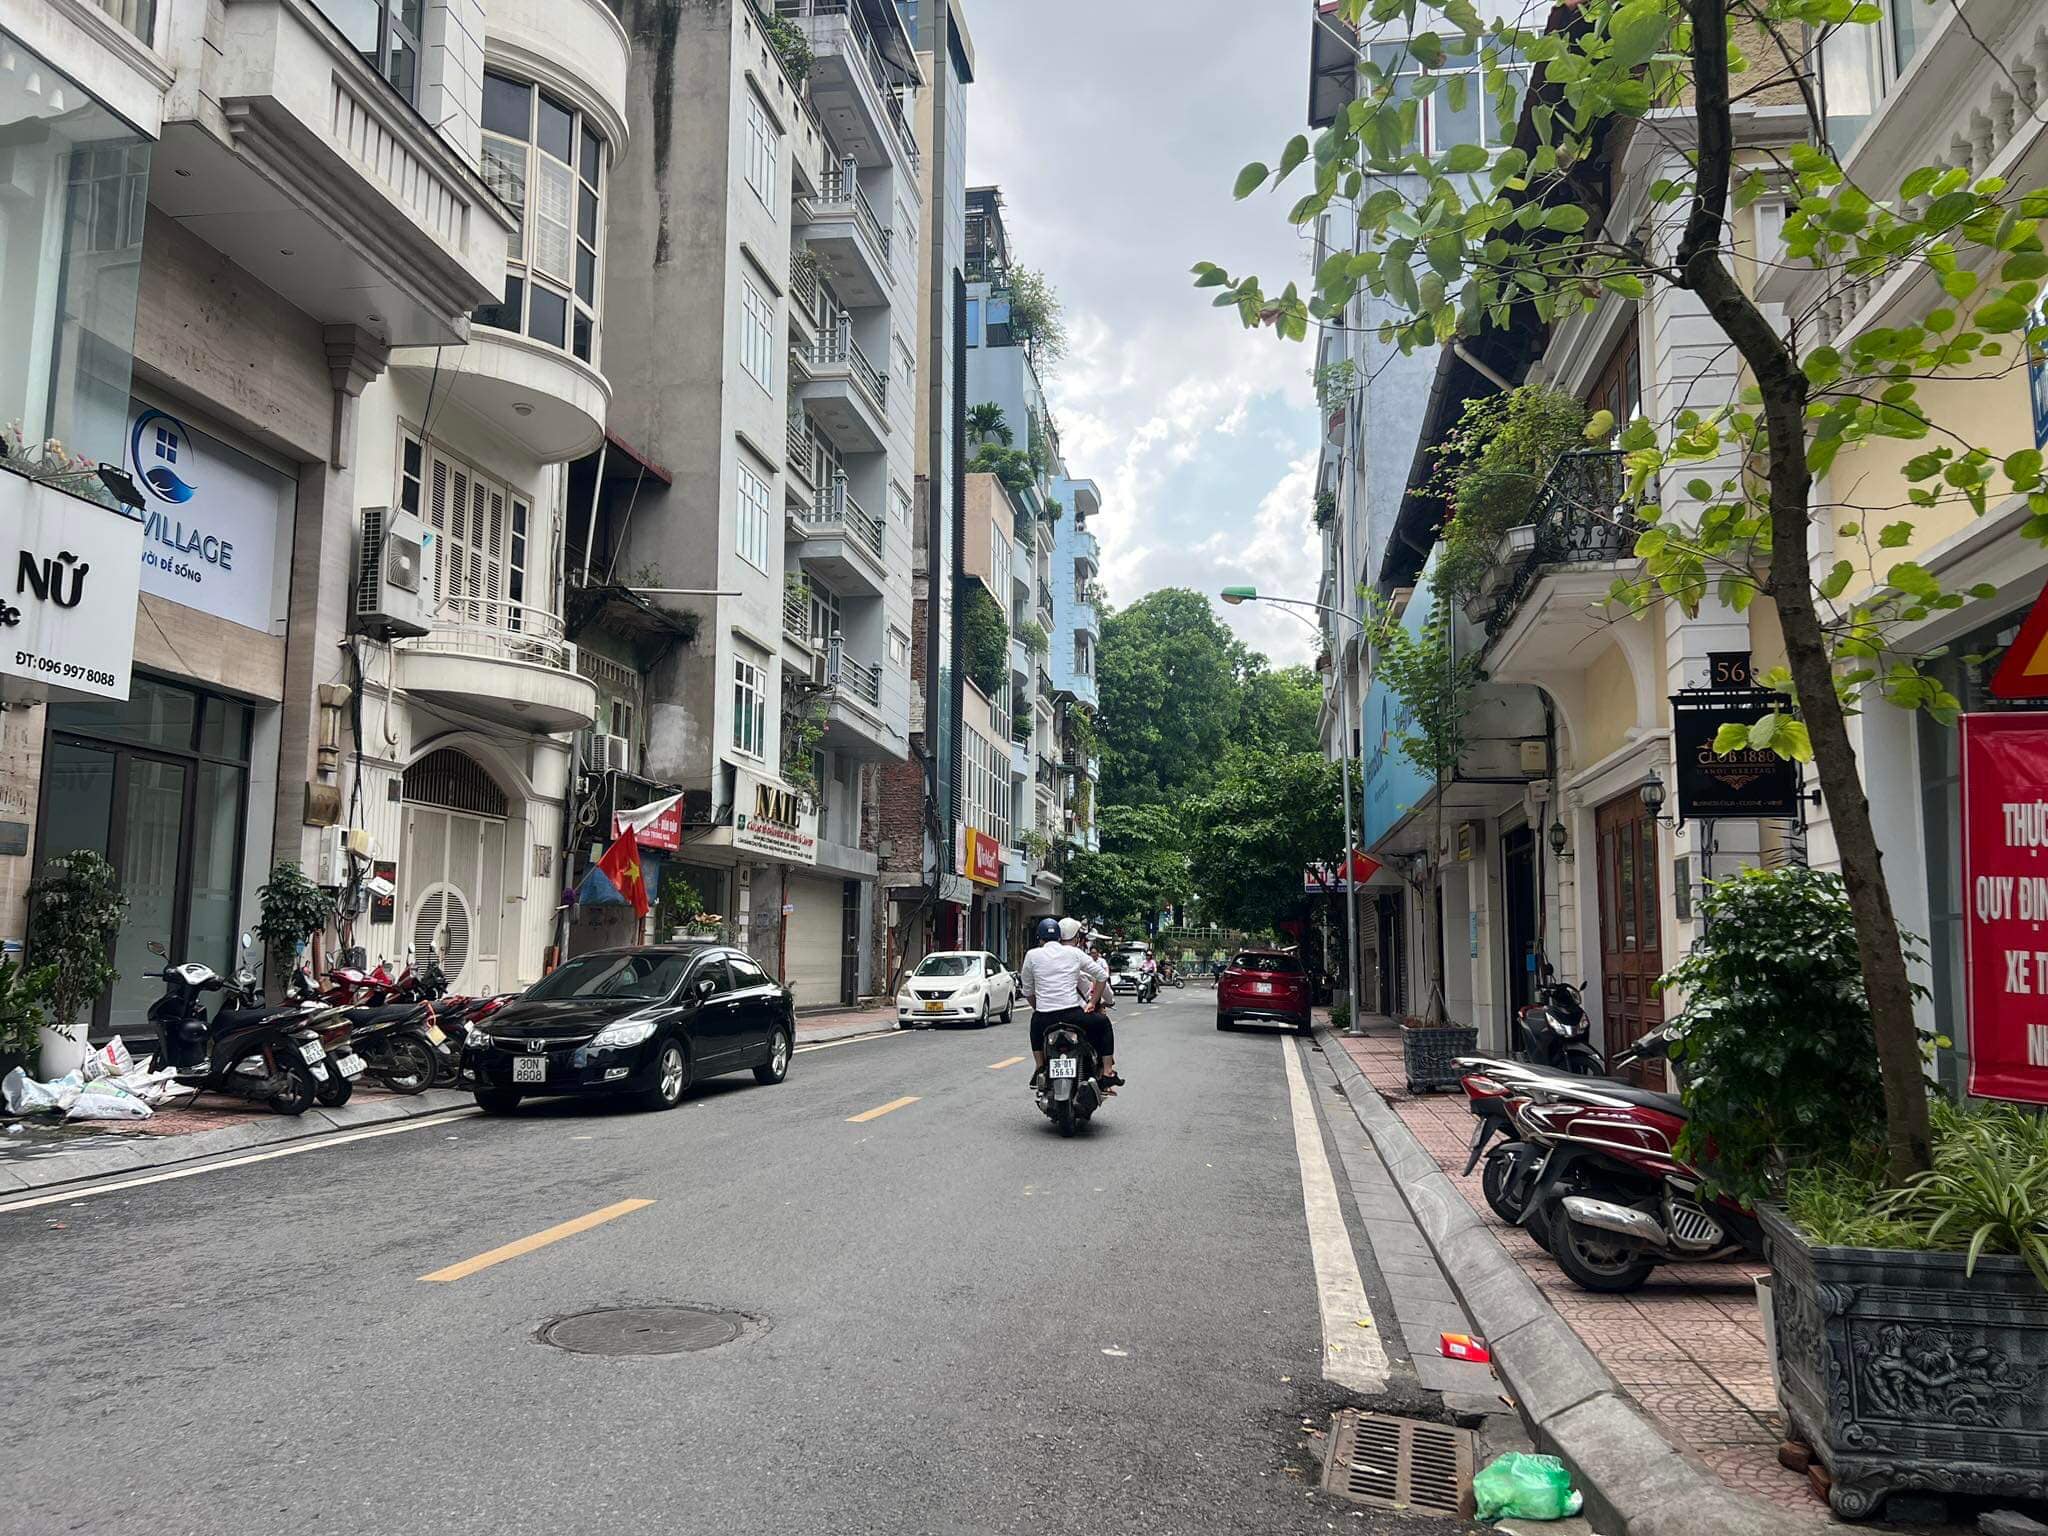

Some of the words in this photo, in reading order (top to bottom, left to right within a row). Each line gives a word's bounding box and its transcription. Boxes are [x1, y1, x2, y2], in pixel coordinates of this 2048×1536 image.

[17, 549, 90, 608] NỮ
[160, 556, 175, 573] ĐỂ
[174, 563, 203, 583] SỐNG
[38, 657, 61, 674] 096
[63, 663, 86, 680] 997
[86, 669, 115, 687] 8088
[1717, 662, 1745, 682] 56
[1698, 750, 1737, 764] CLUB
[1743, 750, 1776, 763] 1880
[1976, 875, 2014, 924] QUY
[2004, 950, 2031, 994] XE
[517, 1070, 542, 1081] 8608
[520, 1059, 539, 1070] 30N
